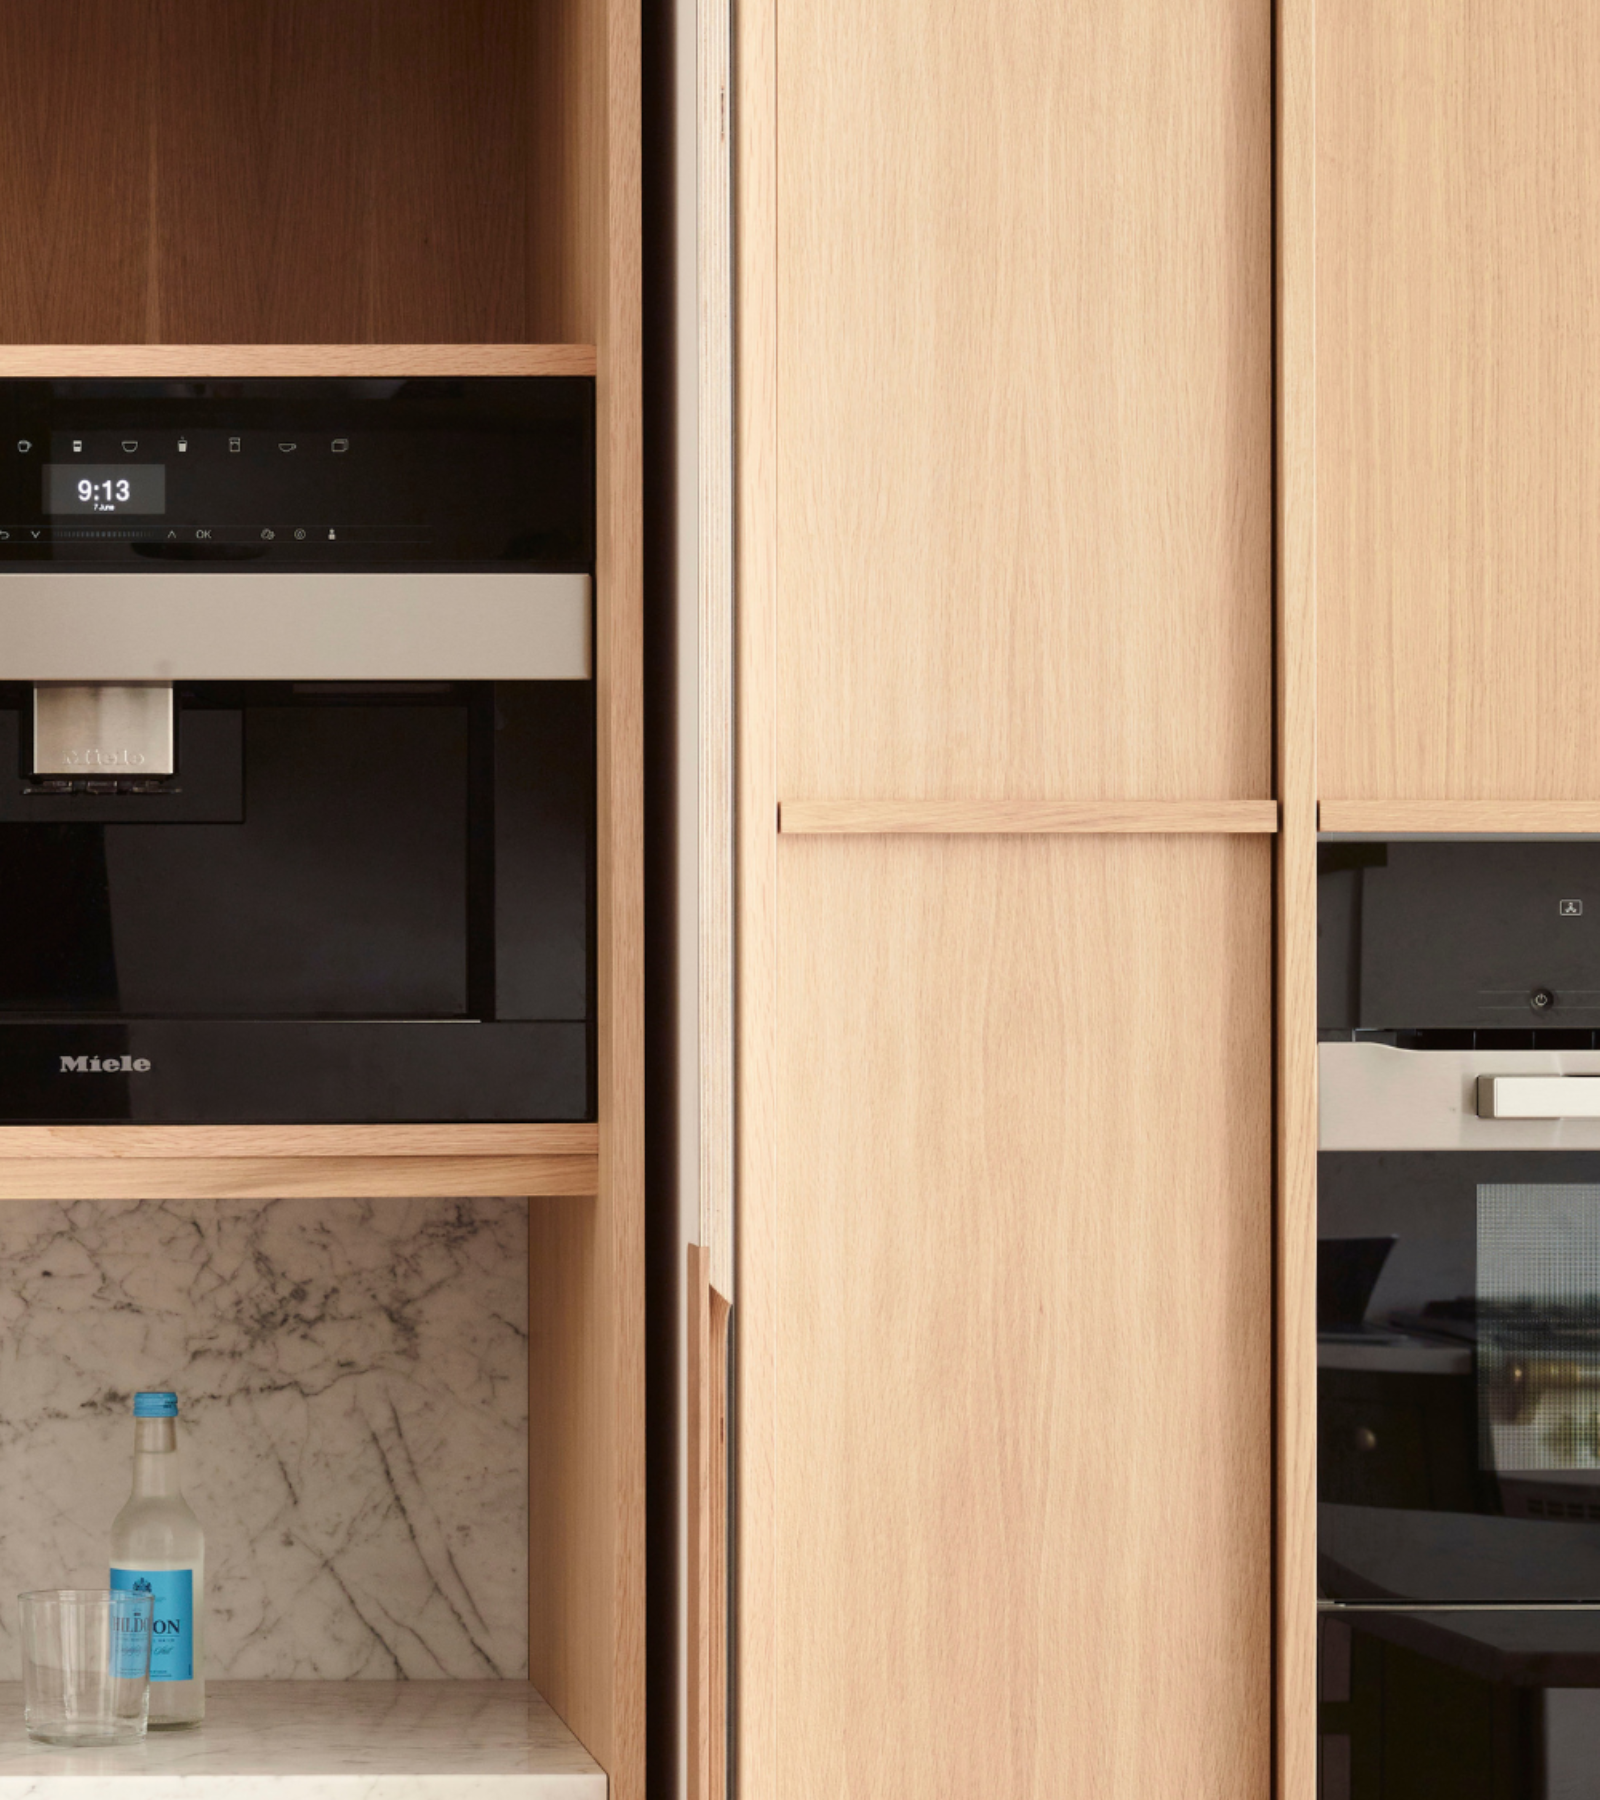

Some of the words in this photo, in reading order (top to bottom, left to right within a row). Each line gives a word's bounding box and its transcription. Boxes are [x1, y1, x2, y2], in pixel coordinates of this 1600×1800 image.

[78, 479, 131, 502] 9:13
[99, 503, 115, 512] June
[195, 529, 212, 539] OK
[60, 1055, 151, 1073] Miele
